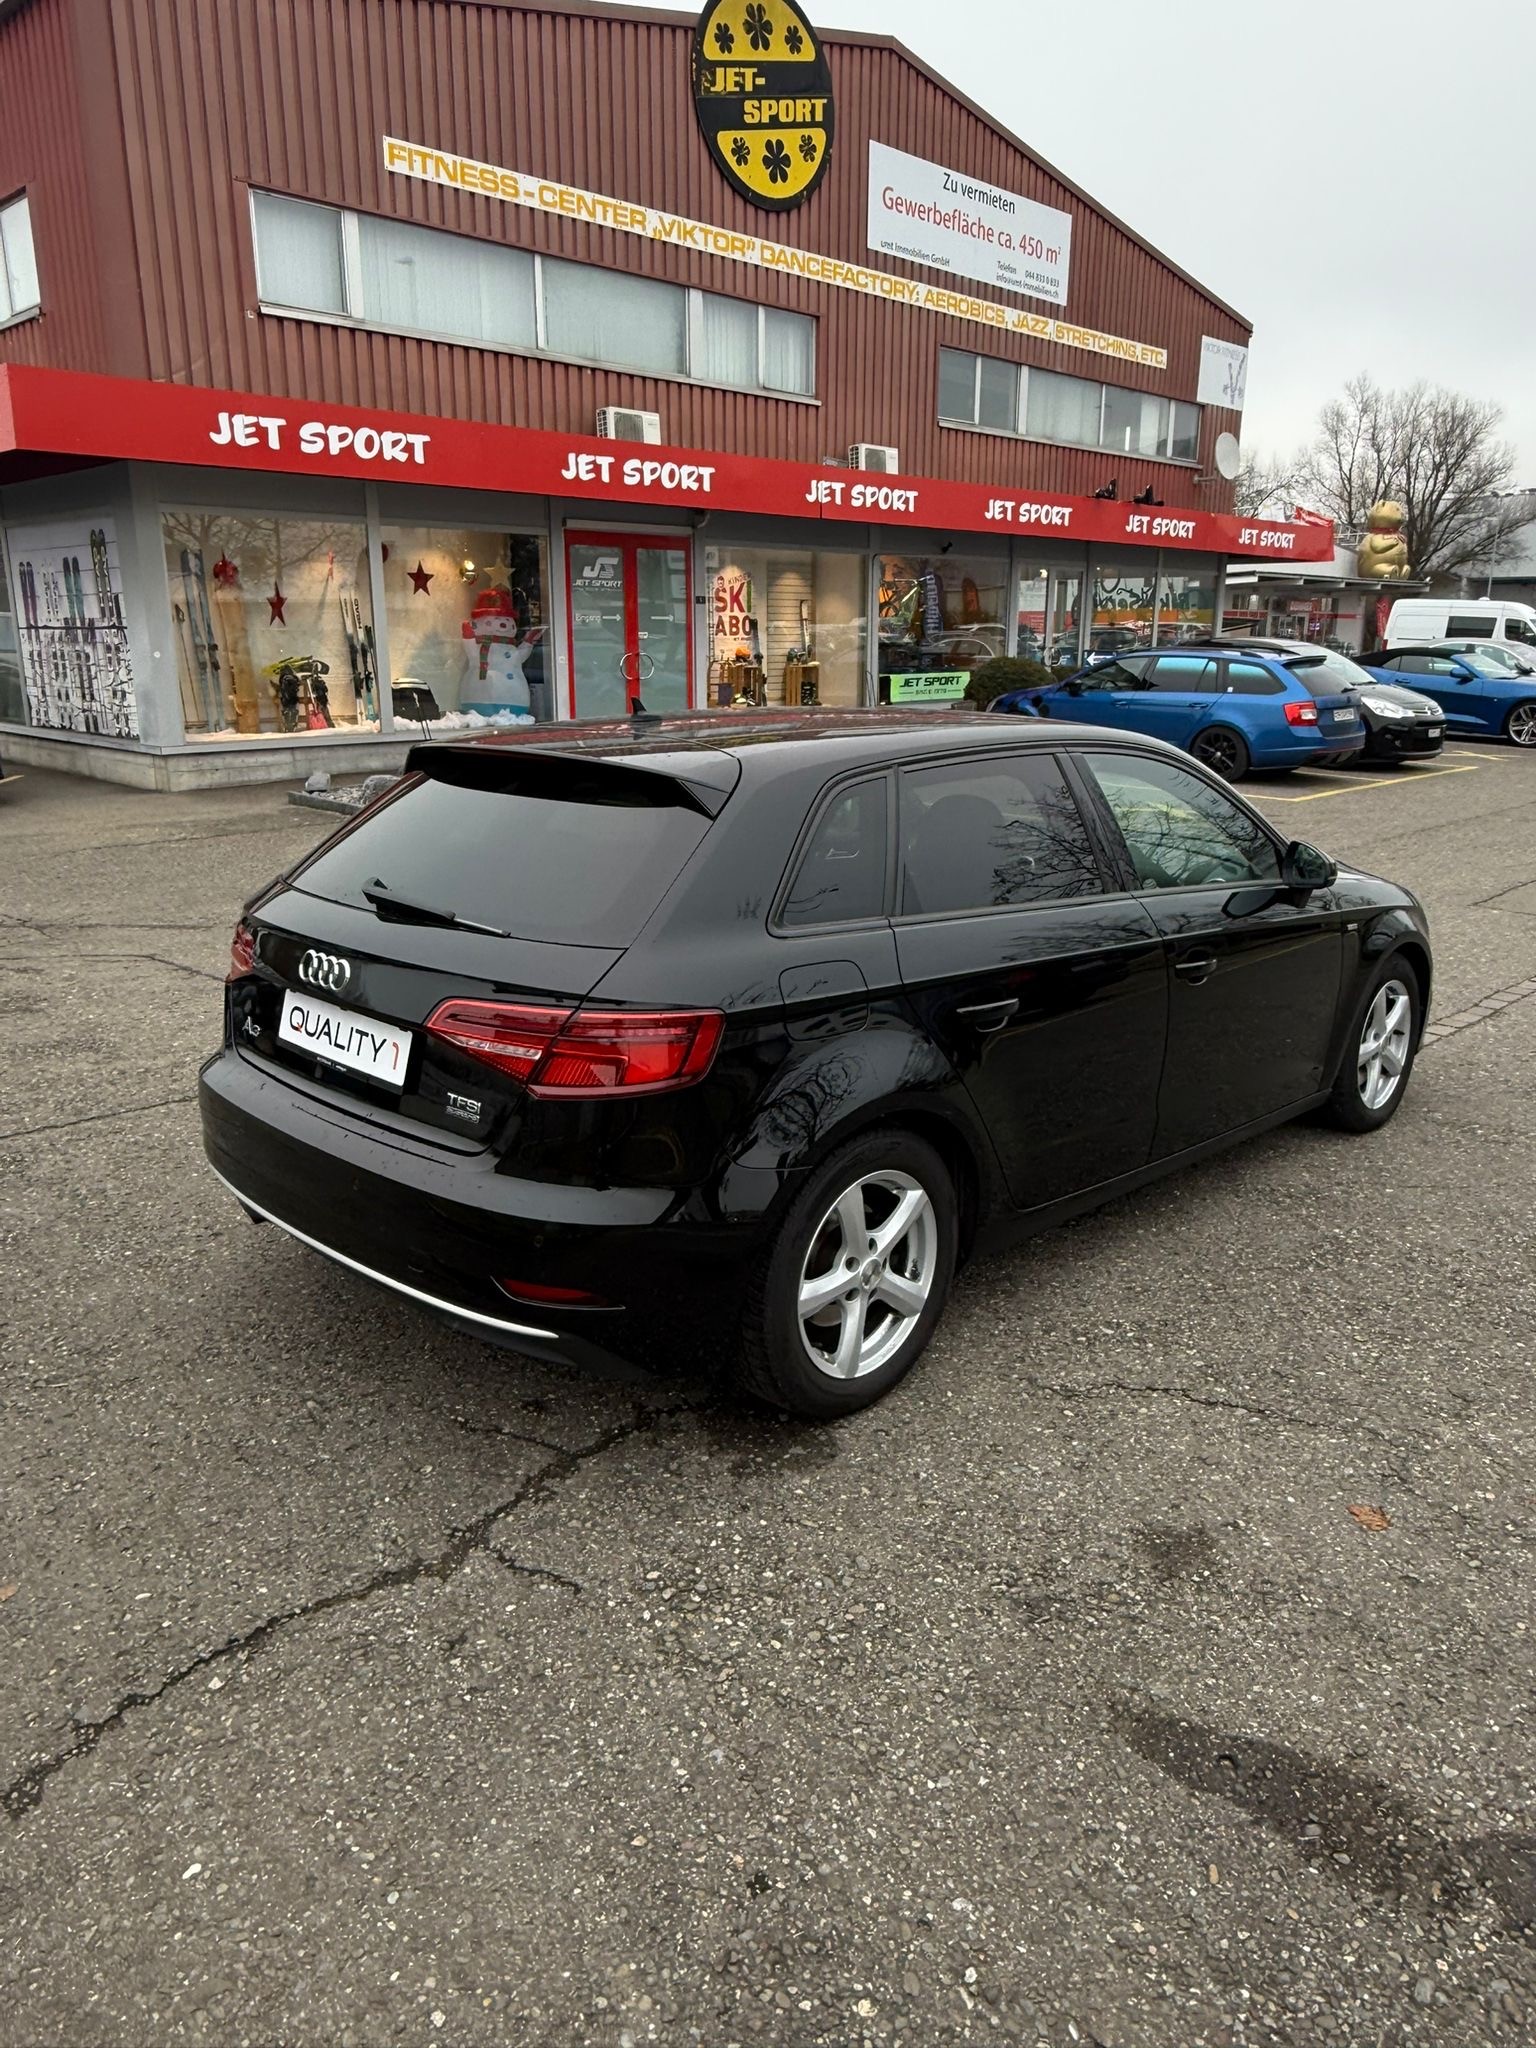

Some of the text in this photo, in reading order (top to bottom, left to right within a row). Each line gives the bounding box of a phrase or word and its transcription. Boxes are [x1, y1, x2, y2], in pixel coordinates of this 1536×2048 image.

[710, 67, 766, 92] JET-
[743, 98, 828, 124] SPORT
[943, 172, 1016, 215] Zu vermieten
[882, 186, 1062, 266] Gewerbefläche ca. 450 m²
[930, 253, 950, 267] GmbH
[209, 412, 431, 465] JET SPORT
[561, 452, 716, 492] JET SPORT
[805, 479, 919, 513] JET SPORT
[984, 499, 1073, 527] JET SPORT
[1125, 514, 1196, 539] JET SPORT
[1238, 527, 1296, 549] JET SPORT
[591, 579, 622, 588] SPORT
[714, 579, 752, 613] SKI
[714, 614, 752, 637] ABO
[899, 675, 962, 688] JET SPORT
[241, 1015, 261, 1038] A3
[447, 1091, 482, 1115] TFSI
